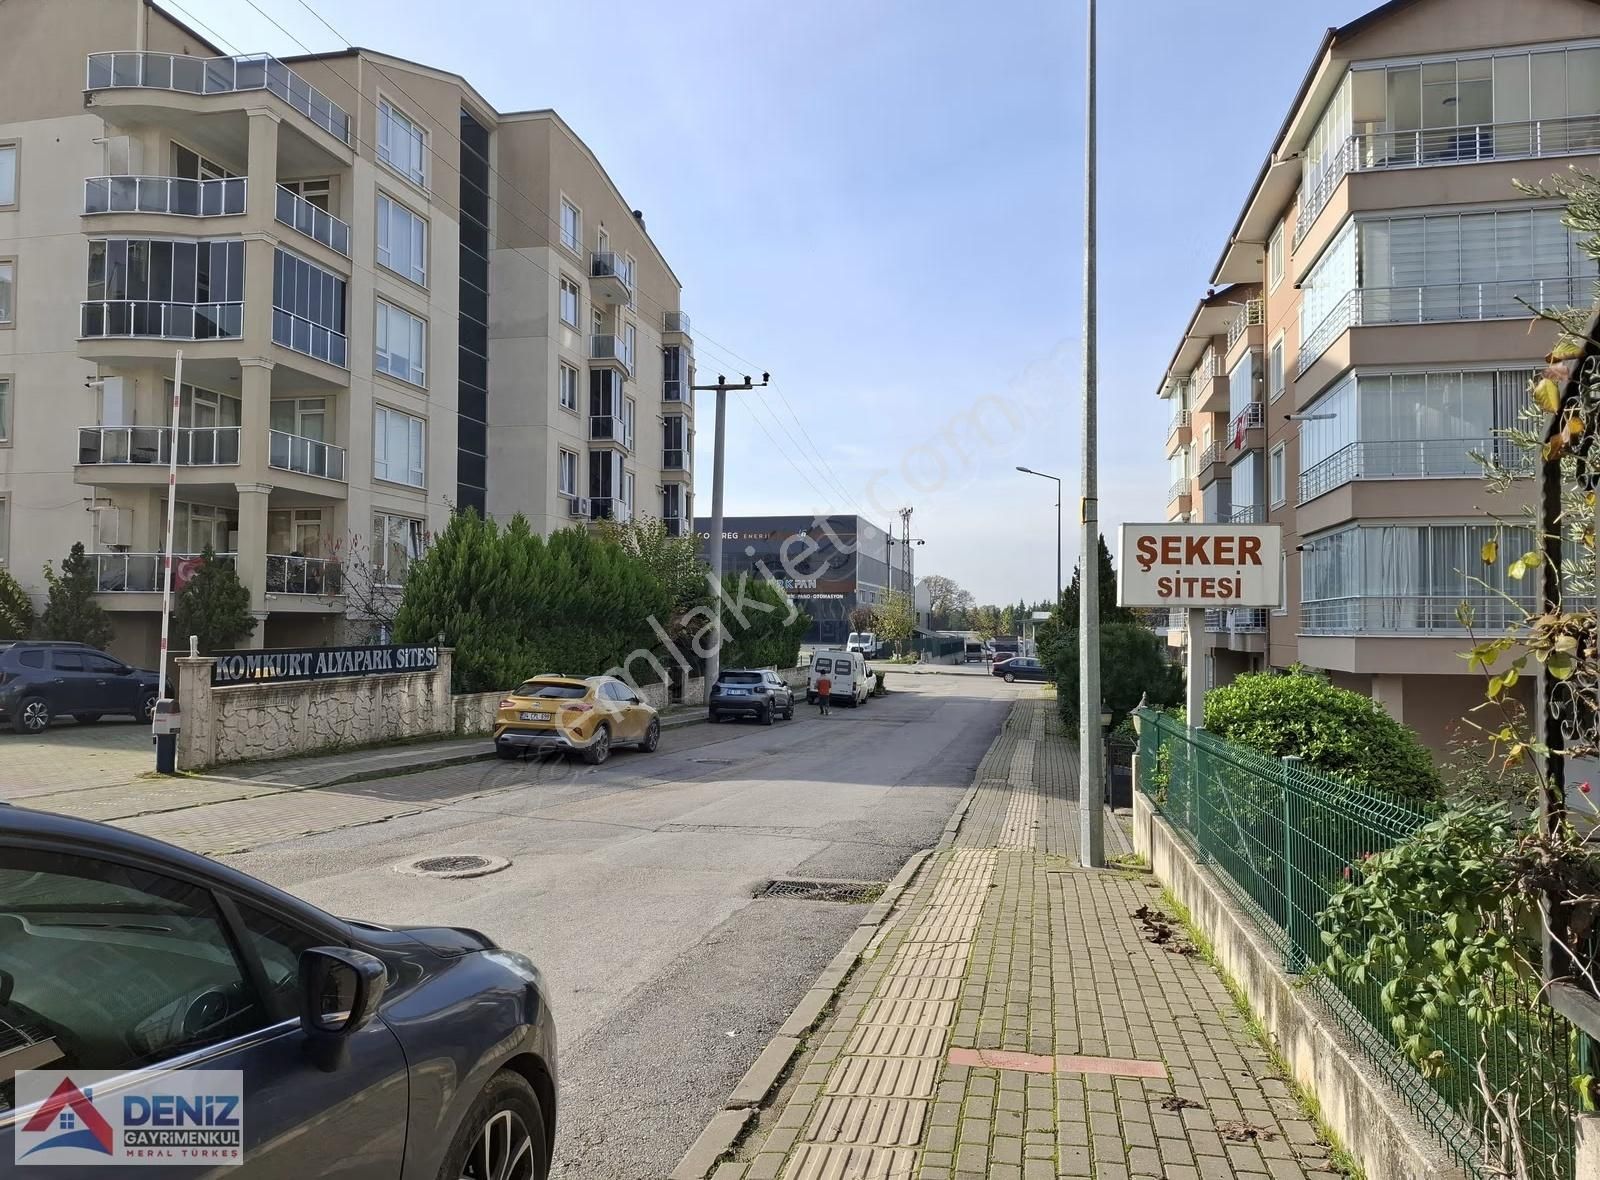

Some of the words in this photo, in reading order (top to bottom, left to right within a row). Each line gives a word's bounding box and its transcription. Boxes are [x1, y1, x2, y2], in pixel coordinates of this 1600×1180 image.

[1135, 535, 1263, 573] ŞEKER
[1157, 569, 1242, 599] SİTESİ
[215, 653, 313, 681] KOMKURT
[315, 649, 393, 674] ALYAPARK
